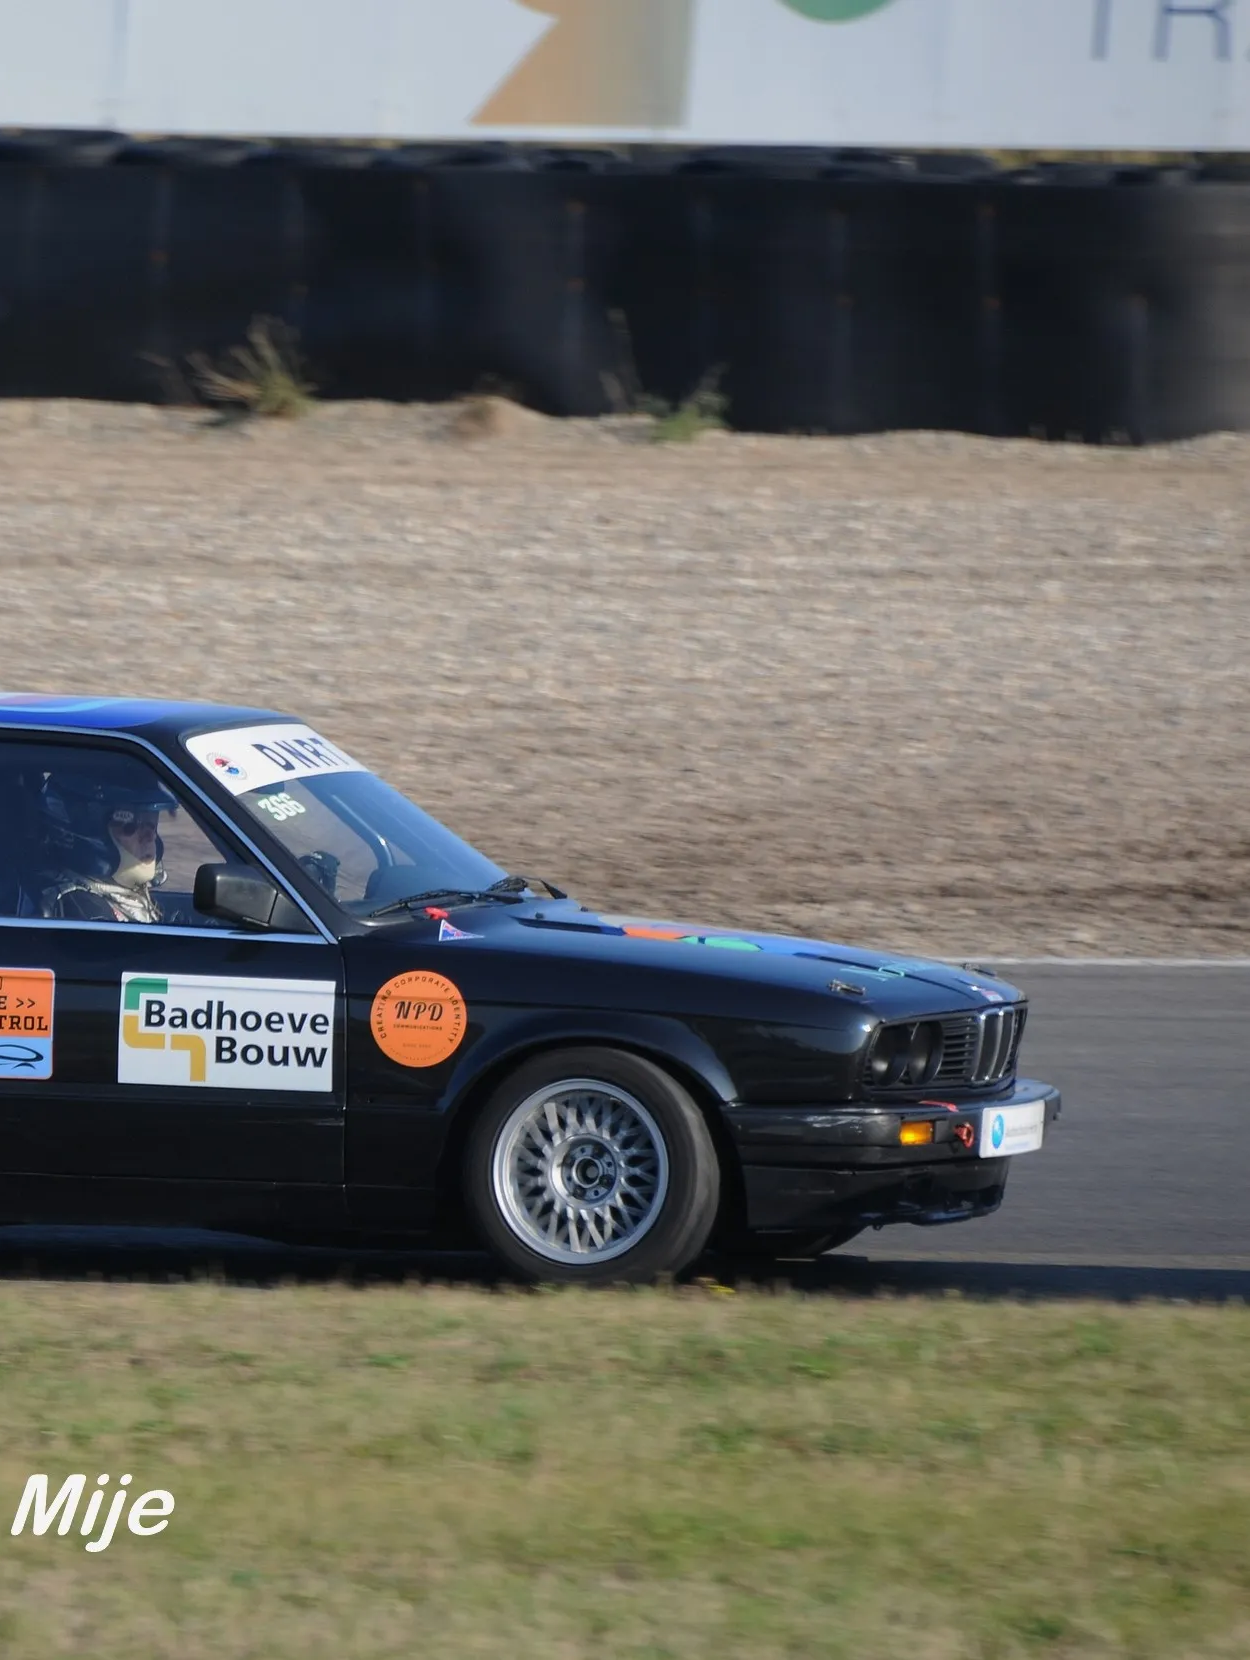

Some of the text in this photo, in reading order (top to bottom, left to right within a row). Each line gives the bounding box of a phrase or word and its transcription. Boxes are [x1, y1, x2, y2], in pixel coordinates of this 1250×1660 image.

[250, 737, 350, 772] DNRT
[257, 792, 306, 821] 366
[143, 998, 330, 1035] Badhoeve
[376, 989, 392, 1039] CREATING
[393, 976, 451, 994] CORPORATE
[394, 1001, 443, 1022] NPD
[214, 1036, 329, 1068] Bouw
